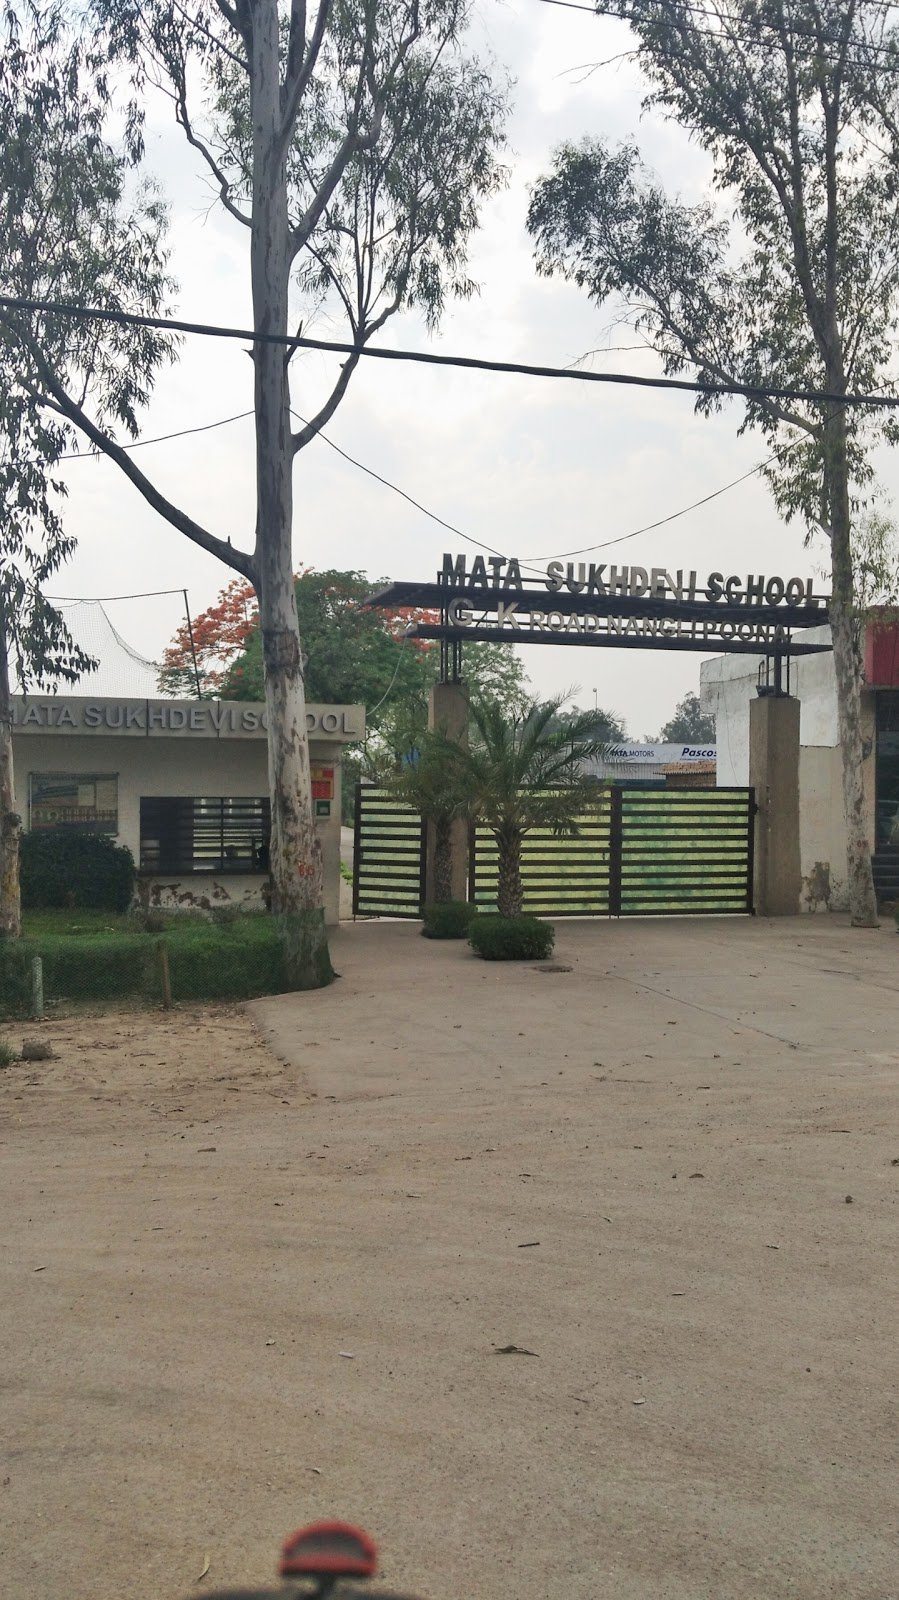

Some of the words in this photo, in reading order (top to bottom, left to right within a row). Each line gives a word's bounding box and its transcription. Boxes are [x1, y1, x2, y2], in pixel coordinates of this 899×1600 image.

[442, 553, 523, 591] MATA
[545, 561, 697, 603] SUKHDEVI
[705, 572, 819, 608] SCHOOL
[448, 597, 475, 627] G
[497, 601, 522, 630] K
[530, 610, 600, 634] ROAD
[84, 706, 237, 731] SUKHDEVI
[241, 709, 356, 734] SOOL
[628, 750, 655, 758] MOTORS
